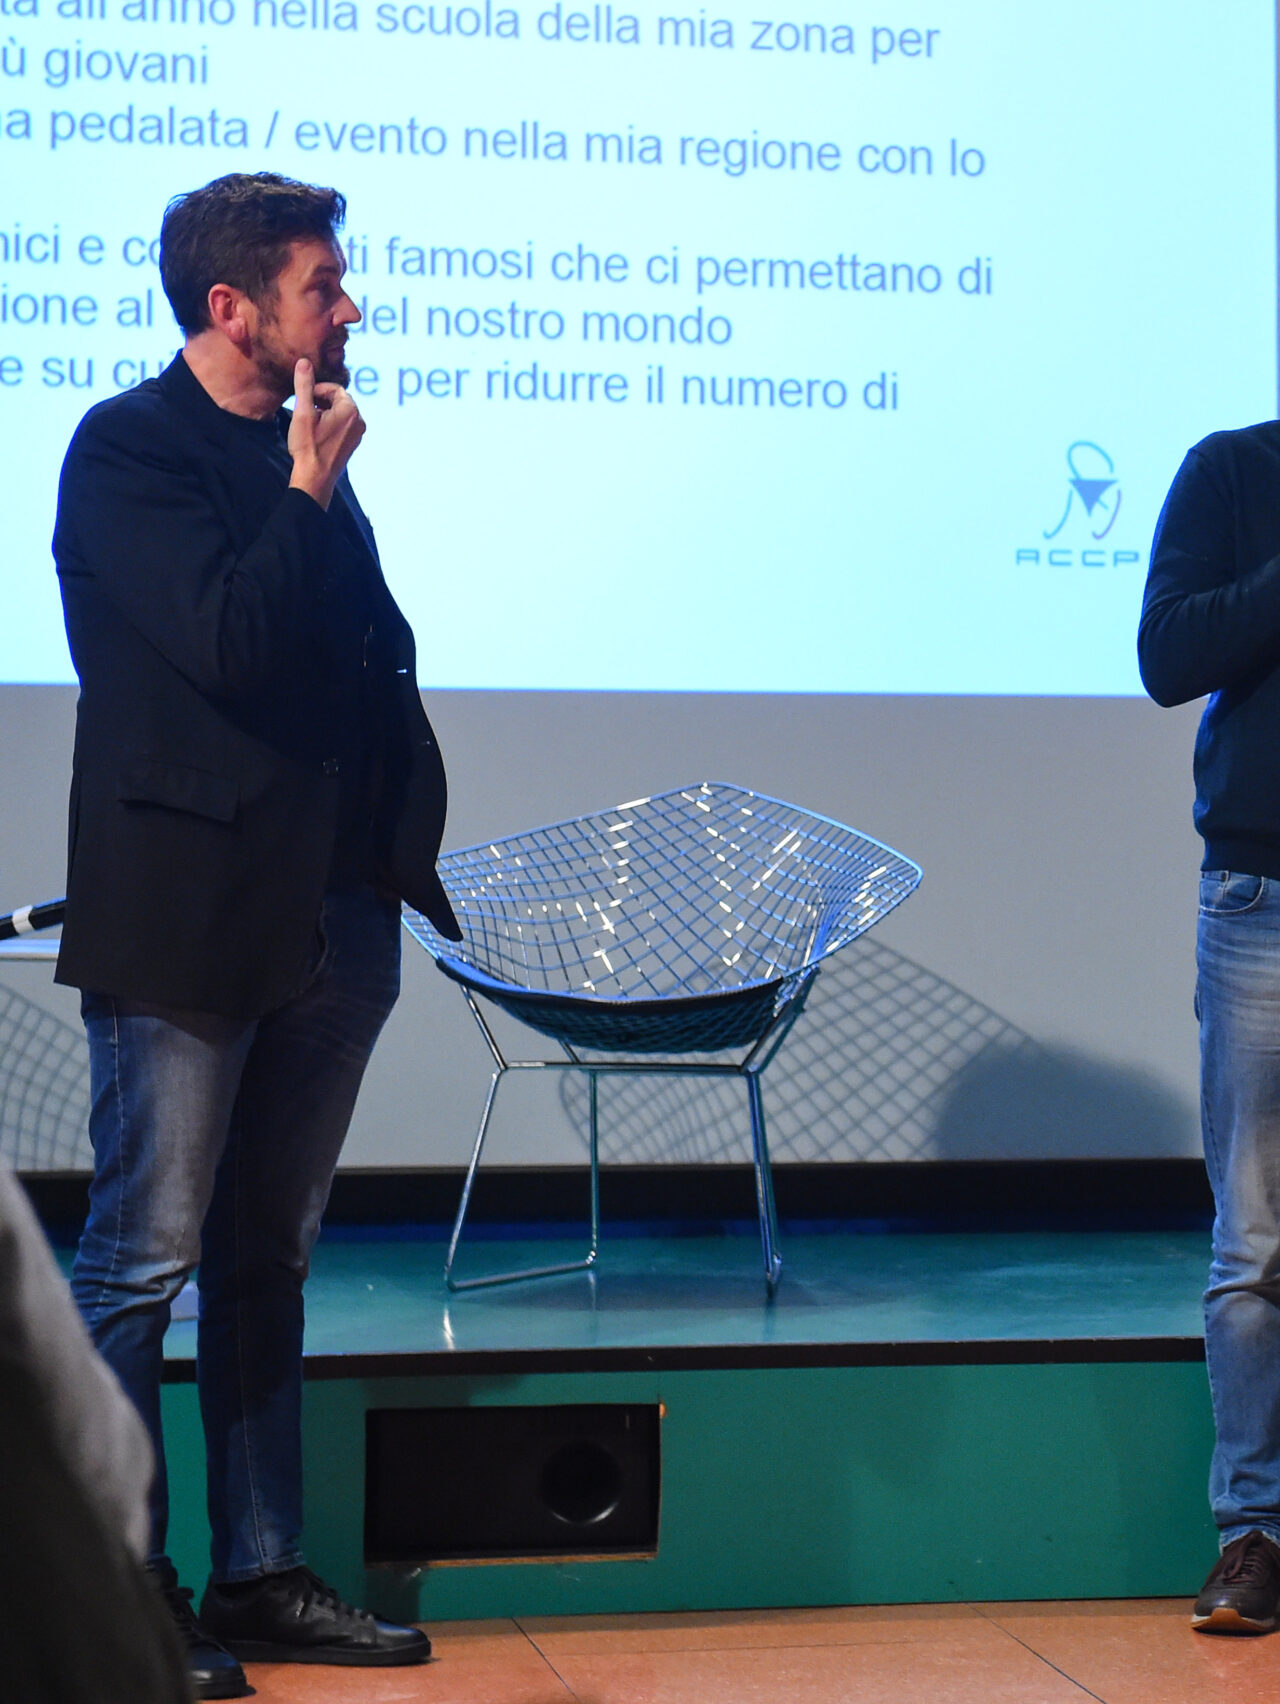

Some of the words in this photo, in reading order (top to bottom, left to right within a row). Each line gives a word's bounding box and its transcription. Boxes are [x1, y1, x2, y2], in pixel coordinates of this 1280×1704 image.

[254, 0, 357, 30] nella
[377, 0, 519, 38] scuola
[538, 3, 640, 44] della
[658, 9, 734, 48] mia
[750, 21, 854, 54] zona
[871, 26, 940, 64] per
[44, 39, 208, 88] giovani
[0, 108, 31, 139] a
[50, 104, 249, 150] pedalata
[265, 110, 279, 149] /
[294, 116, 447, 155] evento
[464, 120, 567, 160] nella
[585, 125, 662, 164] mia
[680, 130, 842, 177] regione
[858, 143, 932, 175] con
[950, 138, 986, 176] lo
[79, 235, 105, 265] e
[386, 236, 533, 280] famosi
[551, 243, 629, 283] che
[646, 246, 679, 284] ci
[697, 252, 942, 294] permettano
[958, 257, 993, 295] di
[116, 288, 153, 327] al
[428, 300, 566, 340] nostro
[582, 306, 733, 345] mondo
[42, 357, 94, 388] su
[113, 351, 176, 389] cu
[398, 367, 470, 406] per
[487, 360, 629, 402] ridurre
[646, 365, 665, 404] il
[682, 376, 848, 409] numero
[863, 371, 898, 410] di
